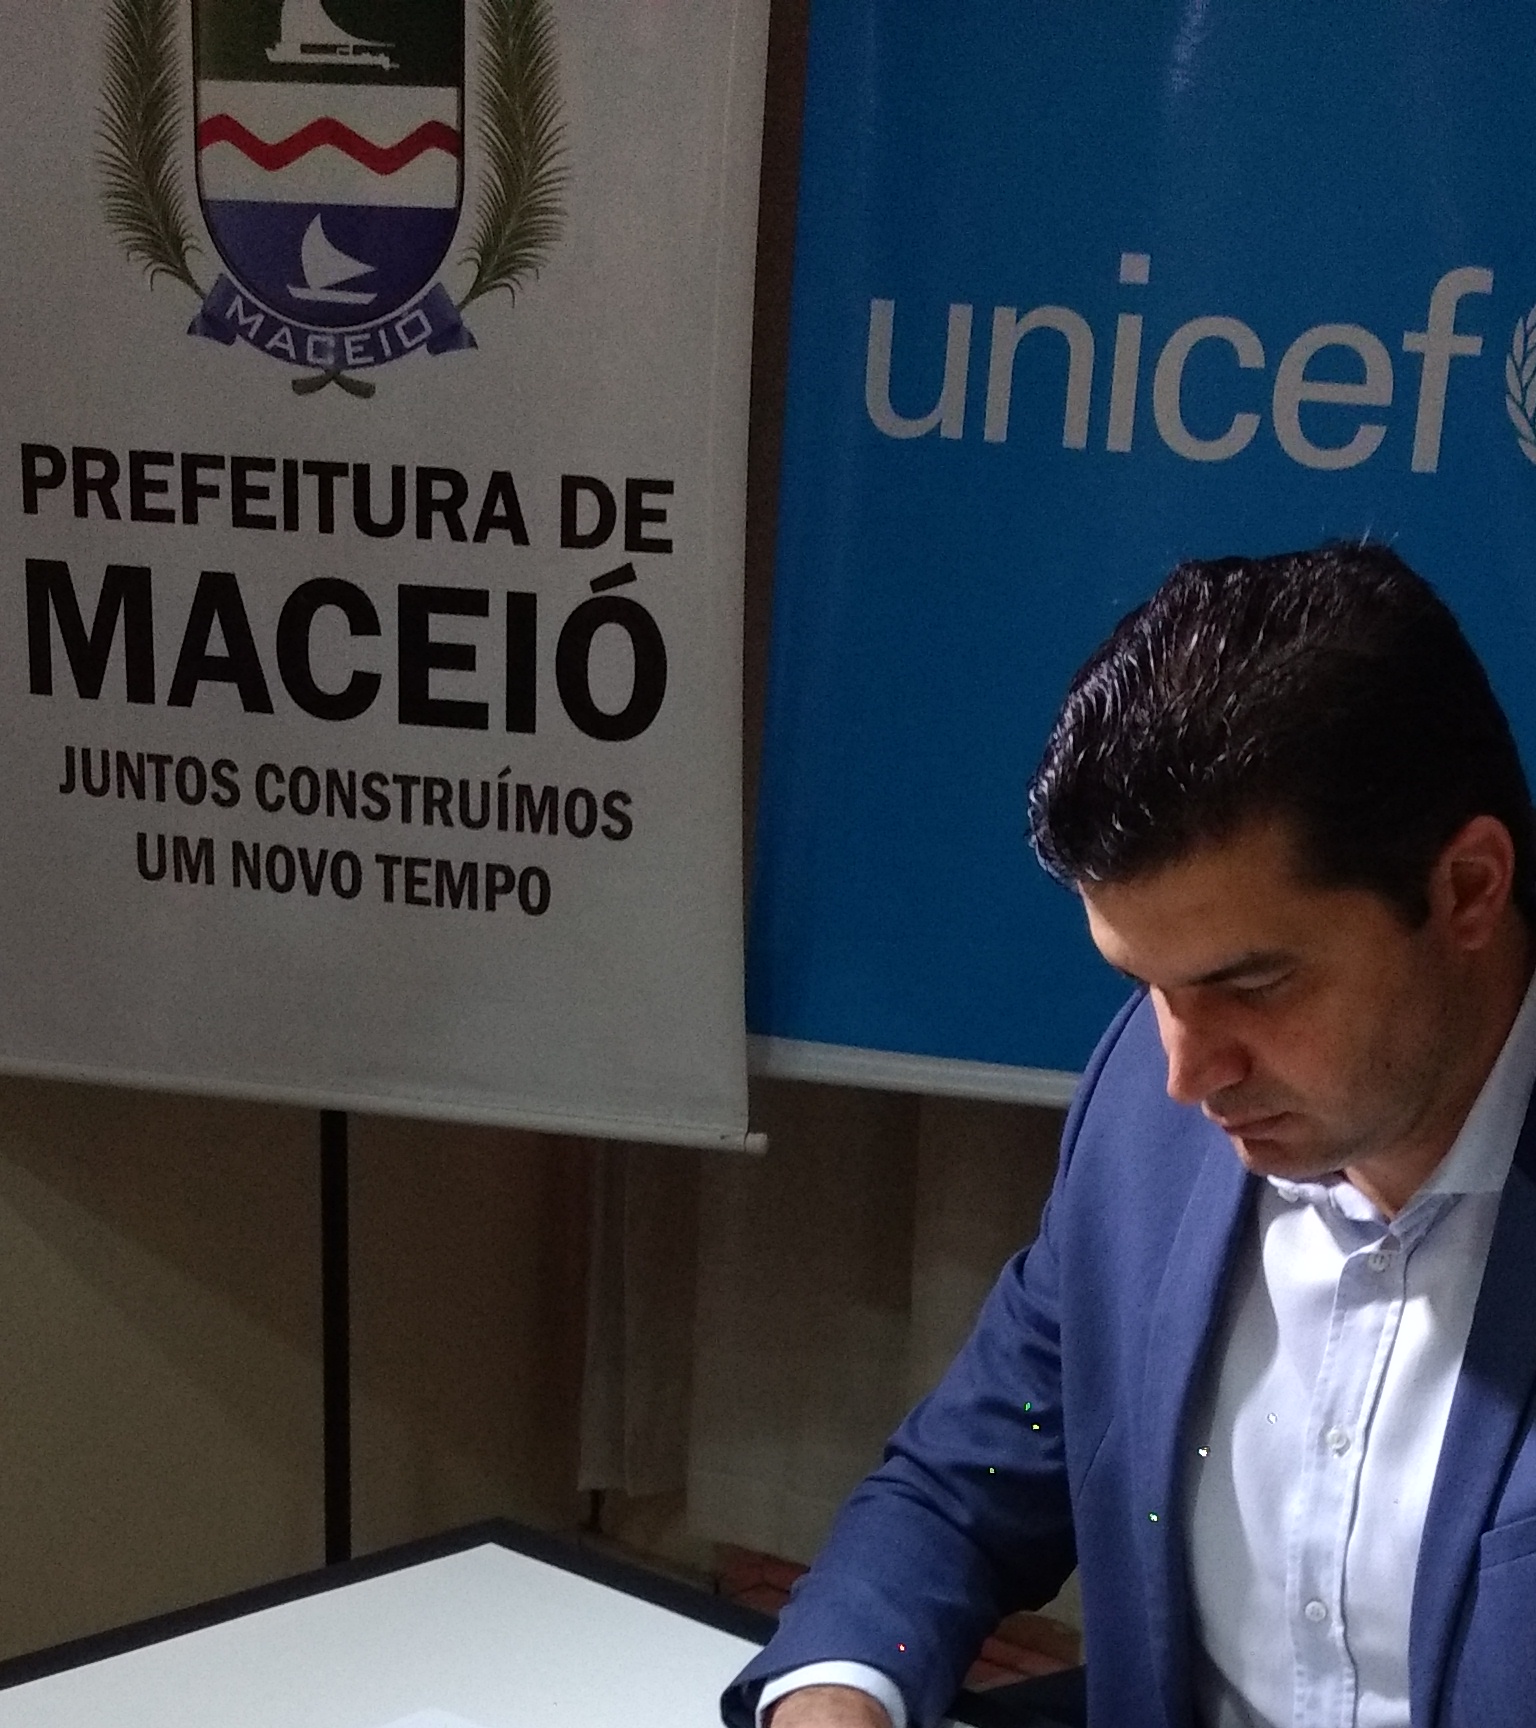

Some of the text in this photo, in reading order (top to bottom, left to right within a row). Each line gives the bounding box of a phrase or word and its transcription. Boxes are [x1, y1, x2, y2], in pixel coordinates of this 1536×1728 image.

[865, 252, 1494, 473] unicef
[19, 441, 676, 556] PREFEITURA DE
[23, 556, 669, 744] MACEIÓ
[57, 743, 634, 843] JUNTOS CONSTRUÍMOS
[134, 830, 553, 918] UM NOVO TEMPO
